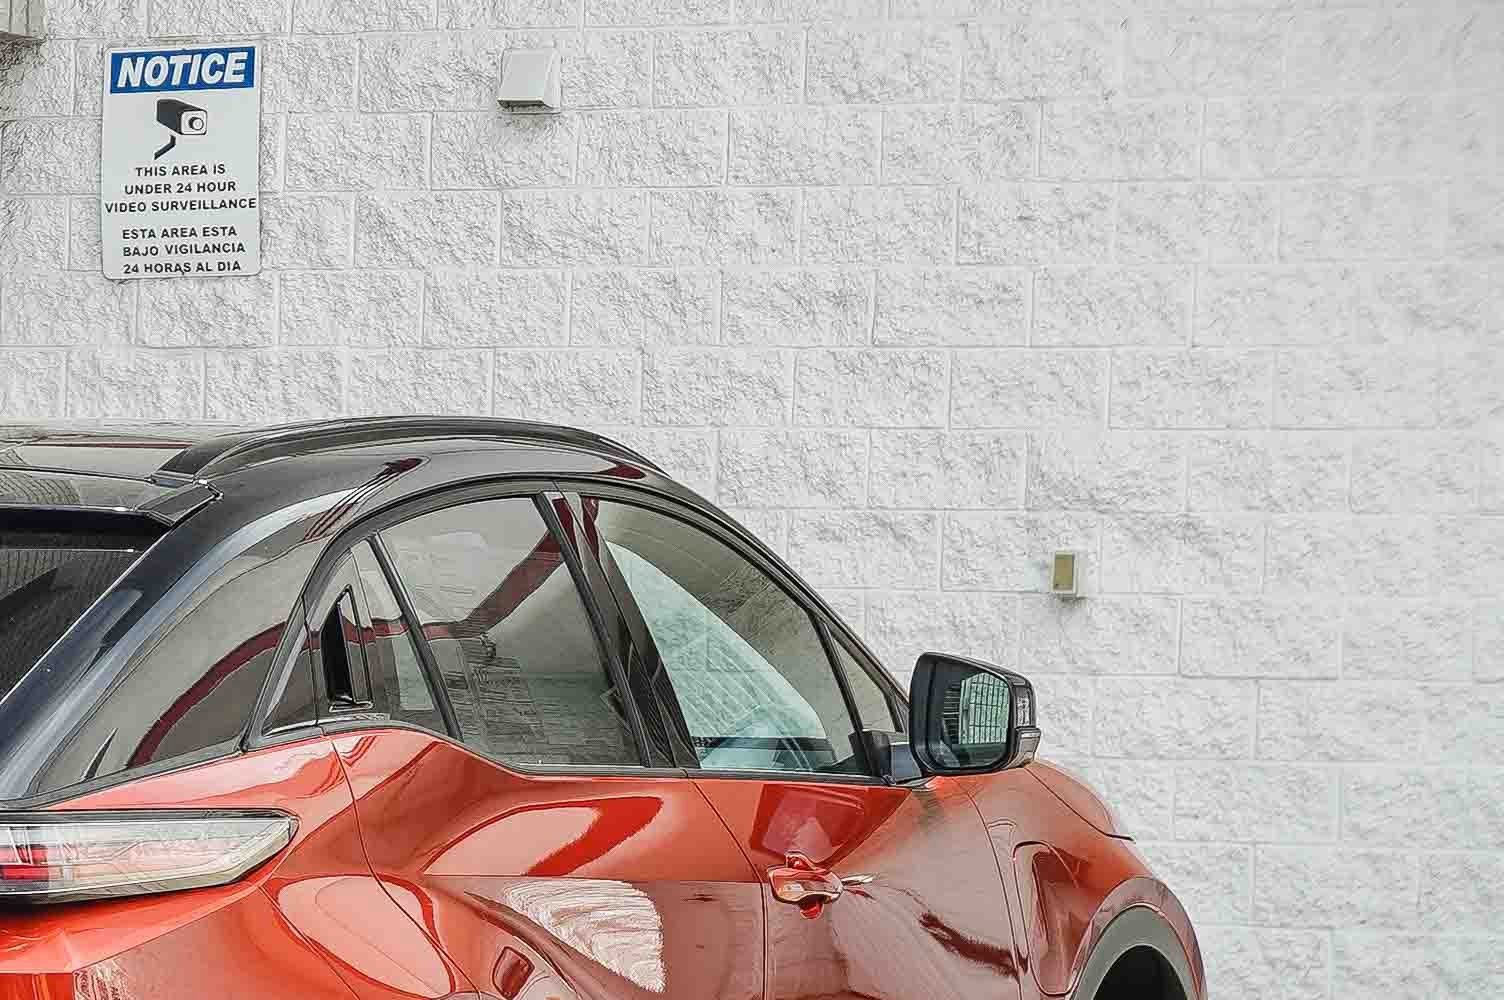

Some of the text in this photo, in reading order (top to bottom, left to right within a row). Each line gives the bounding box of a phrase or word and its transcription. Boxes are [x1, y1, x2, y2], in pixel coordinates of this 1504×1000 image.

[116, 52, 249, 88] NOTICE
[135, 164, 226, 177] THIS AREA IS
[124, 181, 236, 195] UNDER 24 HOUR
[105, 198, 257, 213] VIDEO SURVEILLANCE
[122, 226, 238, 240] ESTA AREA ESTA
[123, 243, 246, 257] BAJO VIGILANCIA
[123, 260, 241, 274] 24 HORAS AL DIA
